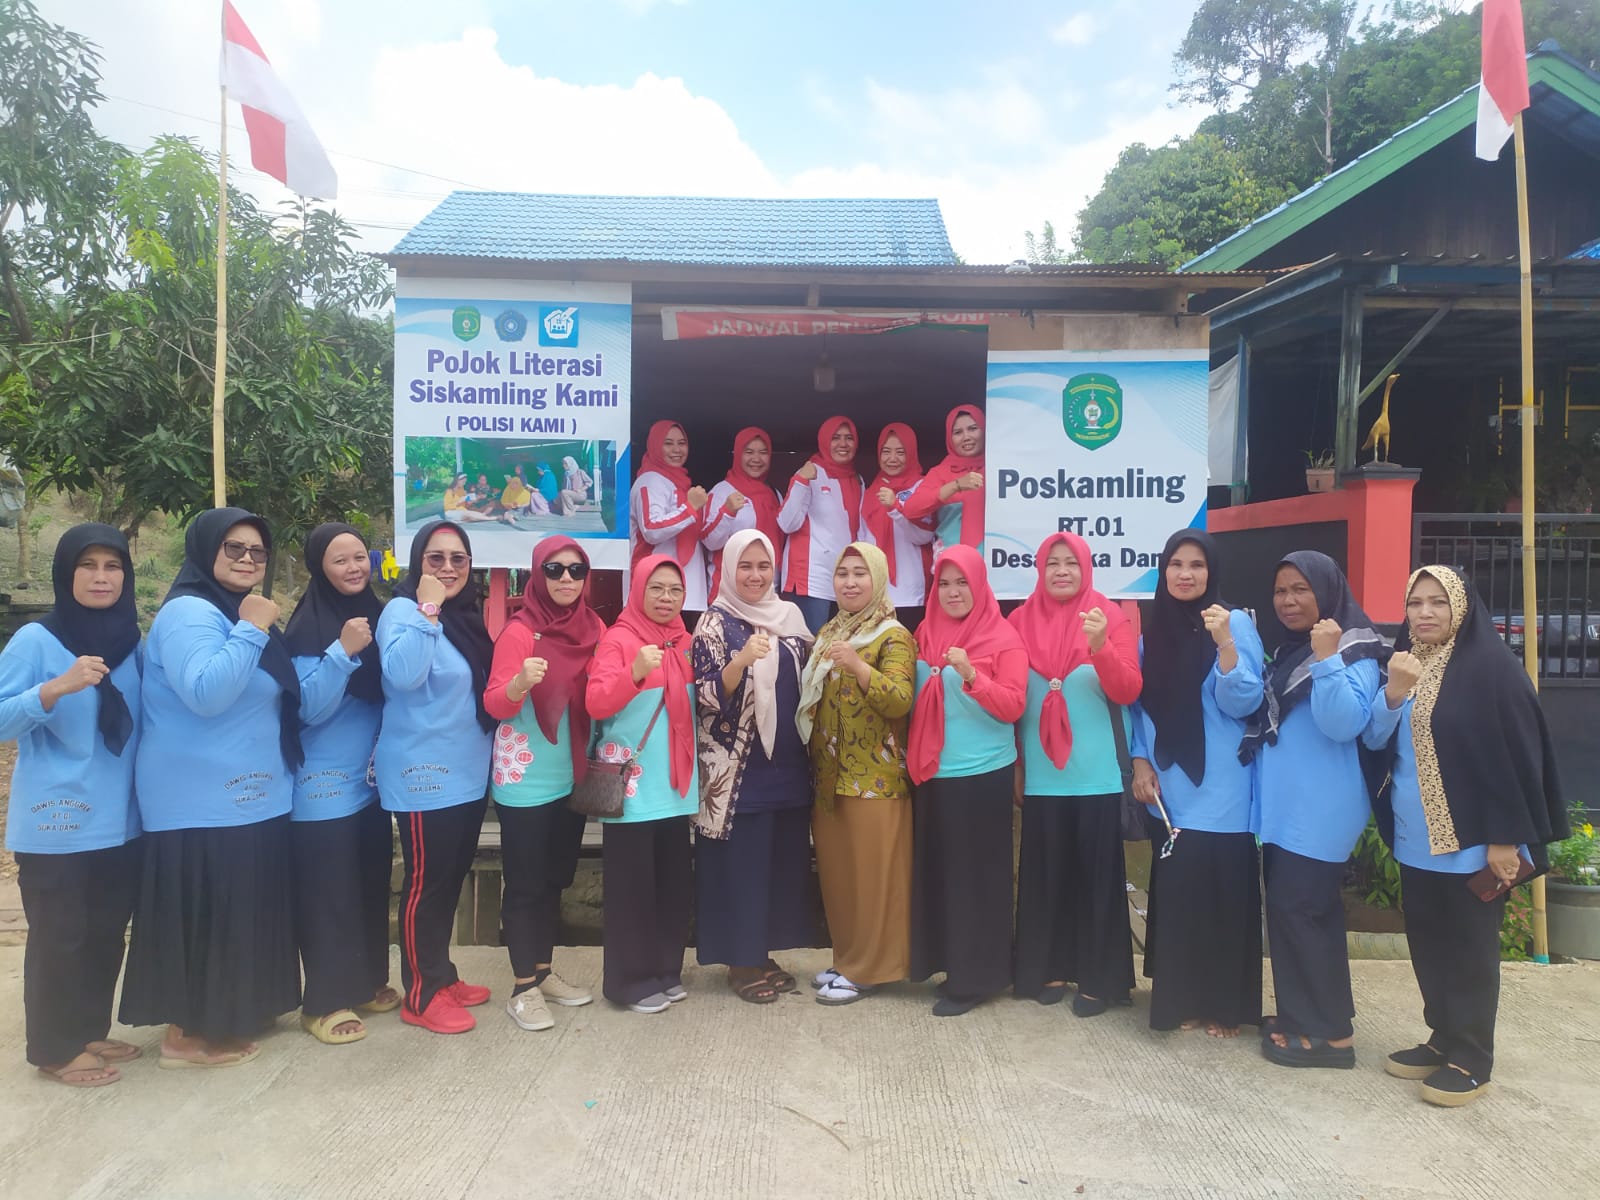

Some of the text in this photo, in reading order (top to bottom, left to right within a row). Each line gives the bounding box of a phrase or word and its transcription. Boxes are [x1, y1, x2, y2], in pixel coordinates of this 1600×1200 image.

[706, 319, 806, 337] JADWAL
[509, 351, 602, 377] Literasi
[409, 379, 619, 410] Siskamling Kami
[457, 416, 514, 432] POLISI
[520, 417, 565, 434] KAMI
[998, 468, 1186, 503] Poskamling
[1058, 516, 1125, 537] RT.01
